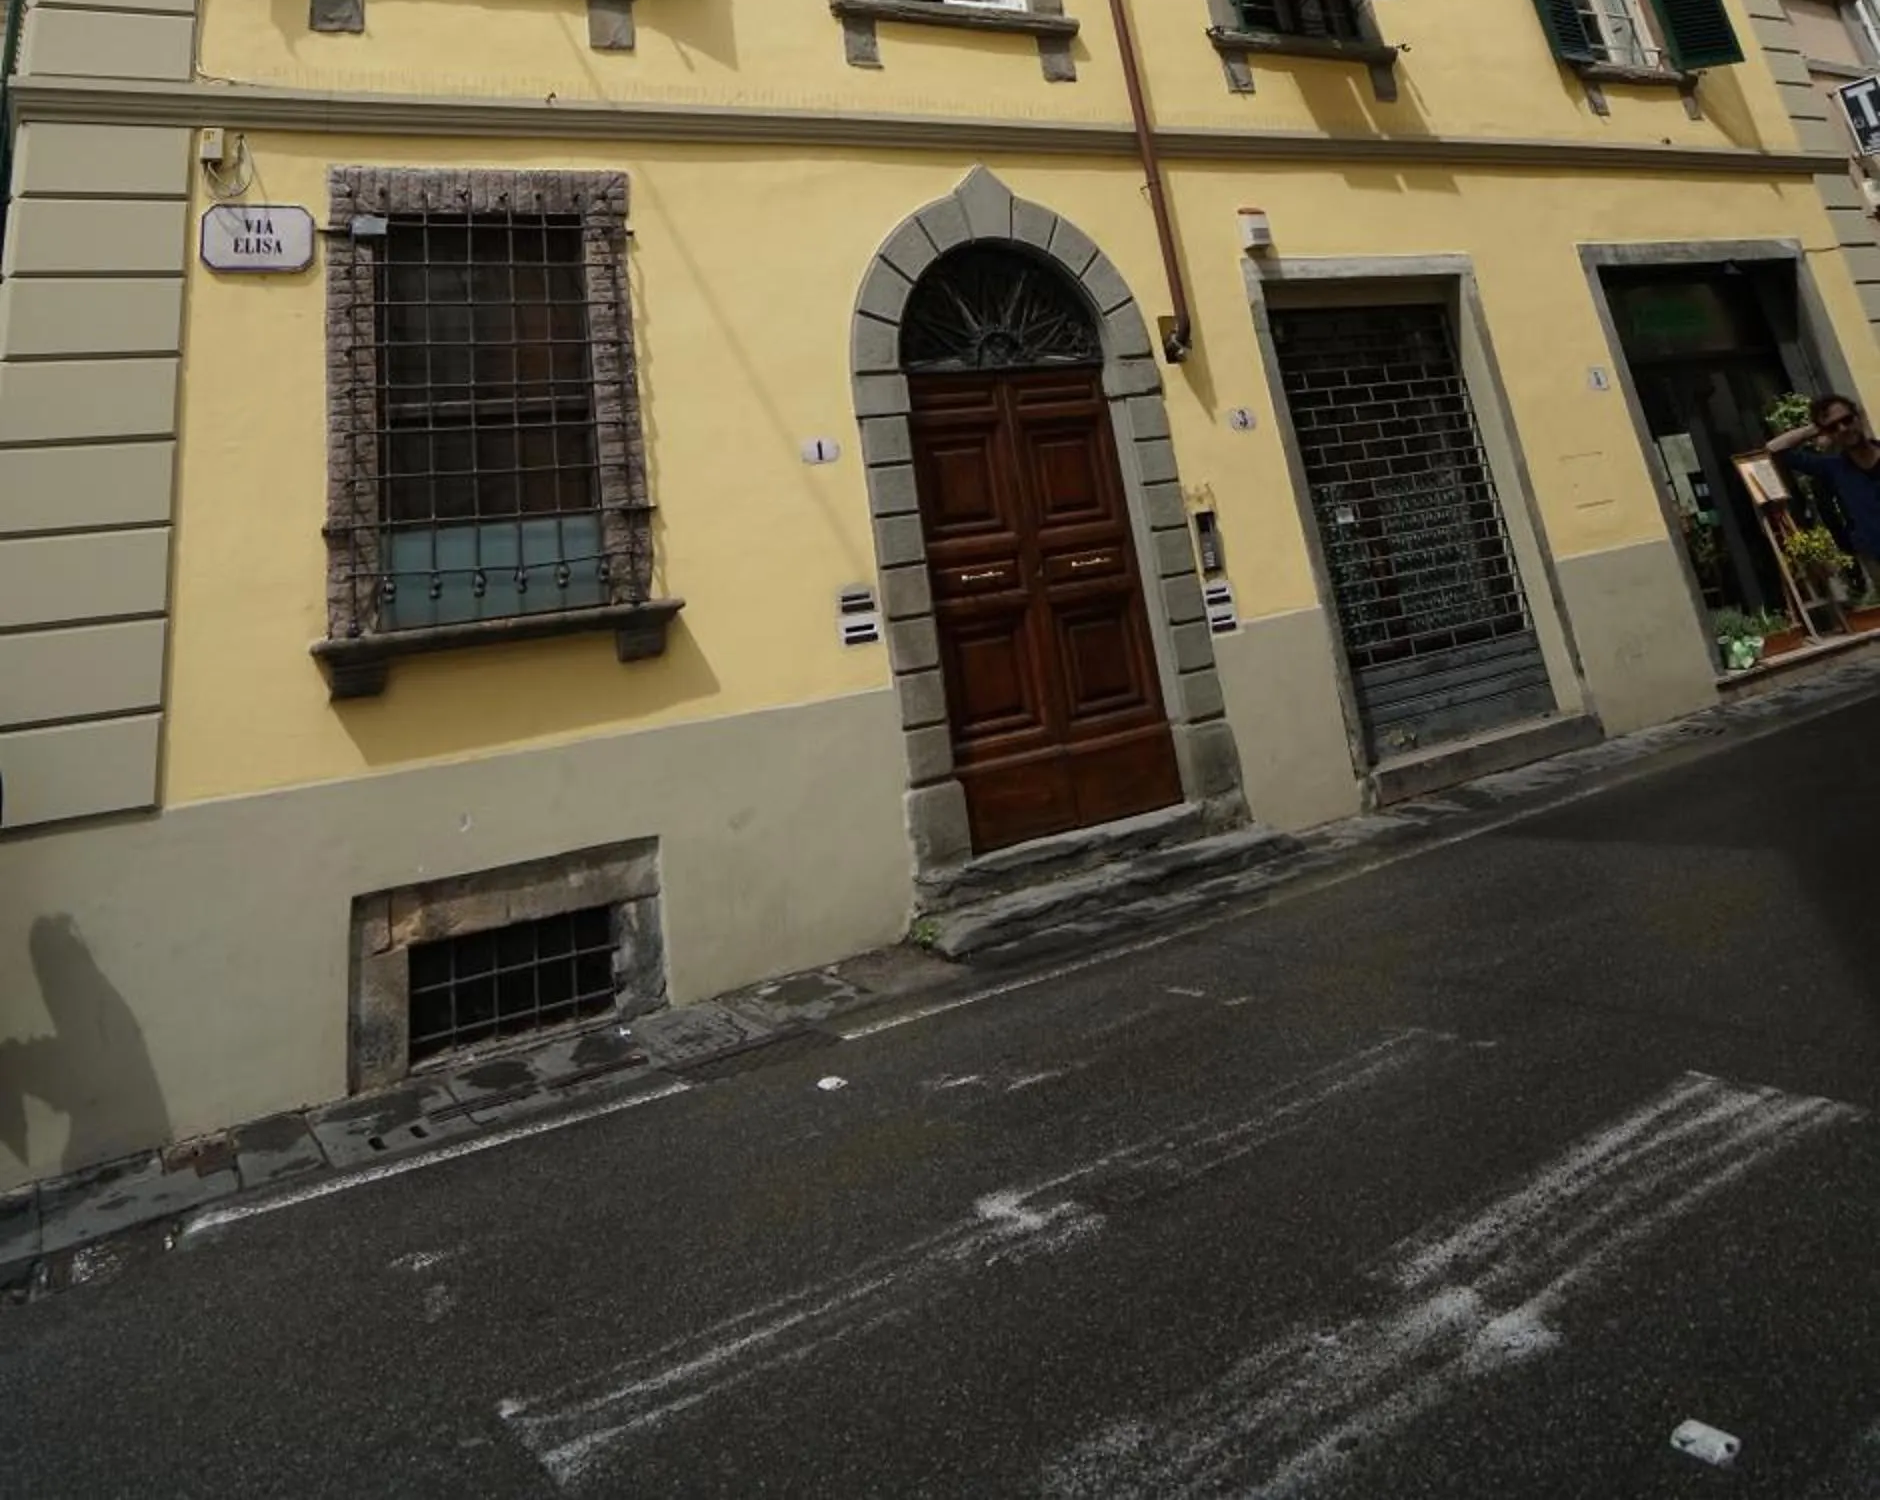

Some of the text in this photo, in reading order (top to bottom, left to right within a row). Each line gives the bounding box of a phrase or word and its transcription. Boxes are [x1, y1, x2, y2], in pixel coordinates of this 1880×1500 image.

[1844, 81, 1879, 129] T
[243, 218, 275, 236] VIA
[232, 237, 283, 256] ELISA
